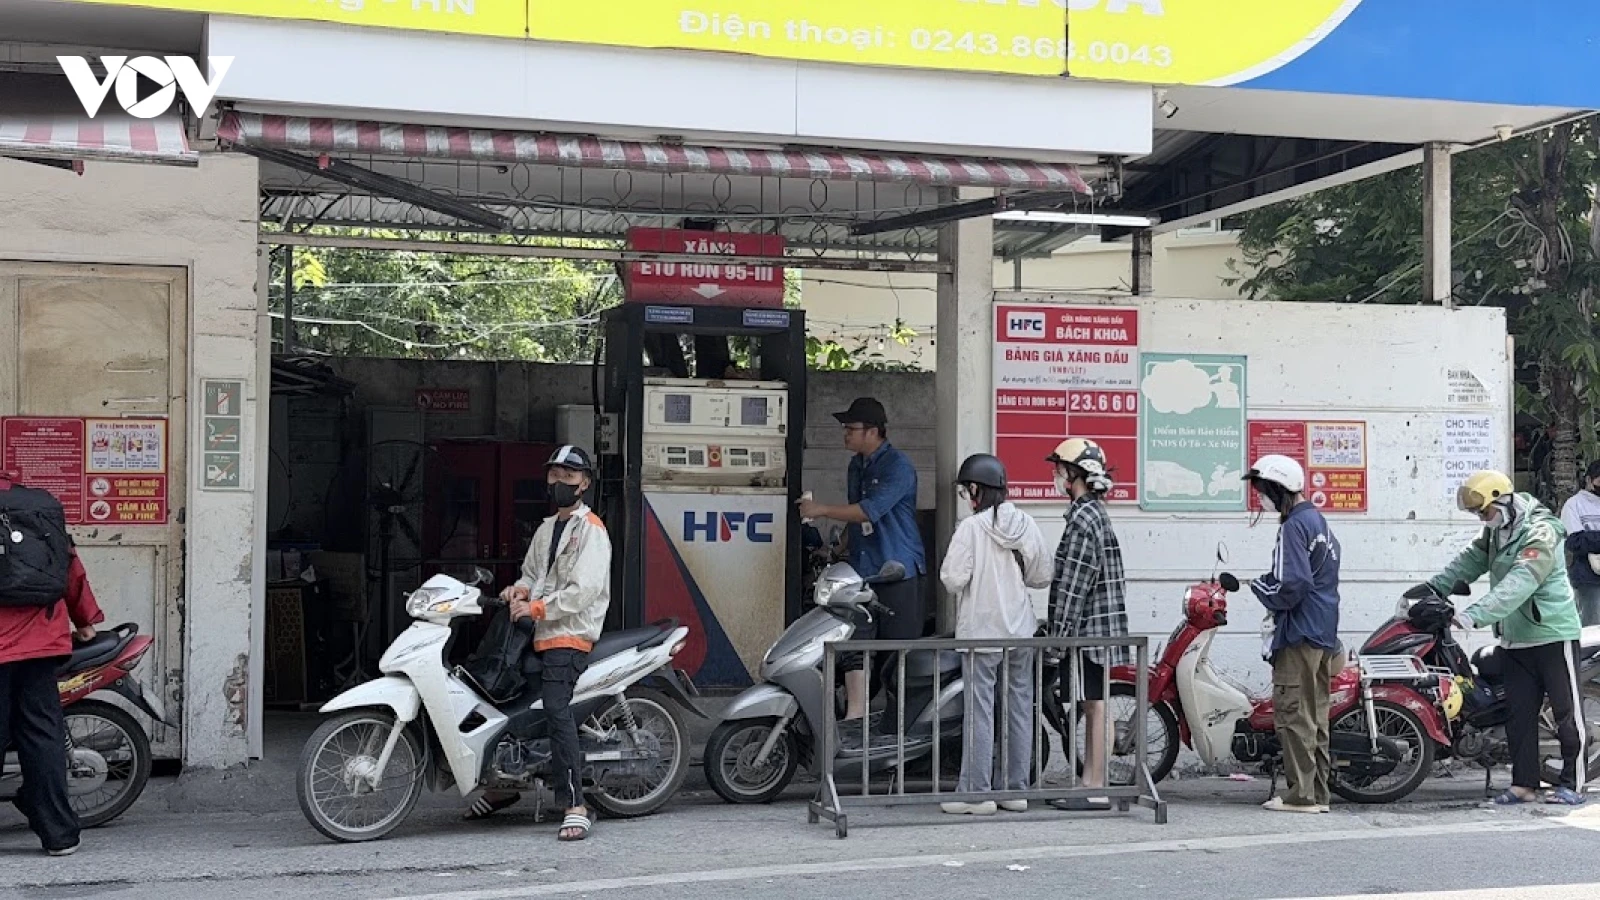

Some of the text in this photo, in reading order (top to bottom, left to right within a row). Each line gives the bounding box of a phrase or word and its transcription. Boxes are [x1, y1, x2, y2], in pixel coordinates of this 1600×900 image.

[679, 10, 1173, 67] Điện thoại: 0243.868.0043
[1010, 319, 1042, 331] HFC
[1056, 325, 1128, 341] BÁCH KHOA
[1005, 347, 1129, 364] BẢNG GIÁ XĂNG DẦU
[998, 395, 1016, 406] XĂNG
[1070, 393, 1136, 411] 23.660
[1445, 417, 1490, 429] CHO THUÊ
[1445, 459, 1490, 470] CHO THUÊ
[1023, 488, 1043, 498] GIAN
[116, 500, 159, 511] CẤM LỬA
[120, 512, 156, 520] NO FIRE
[683, 511, 773, 543] HFC
